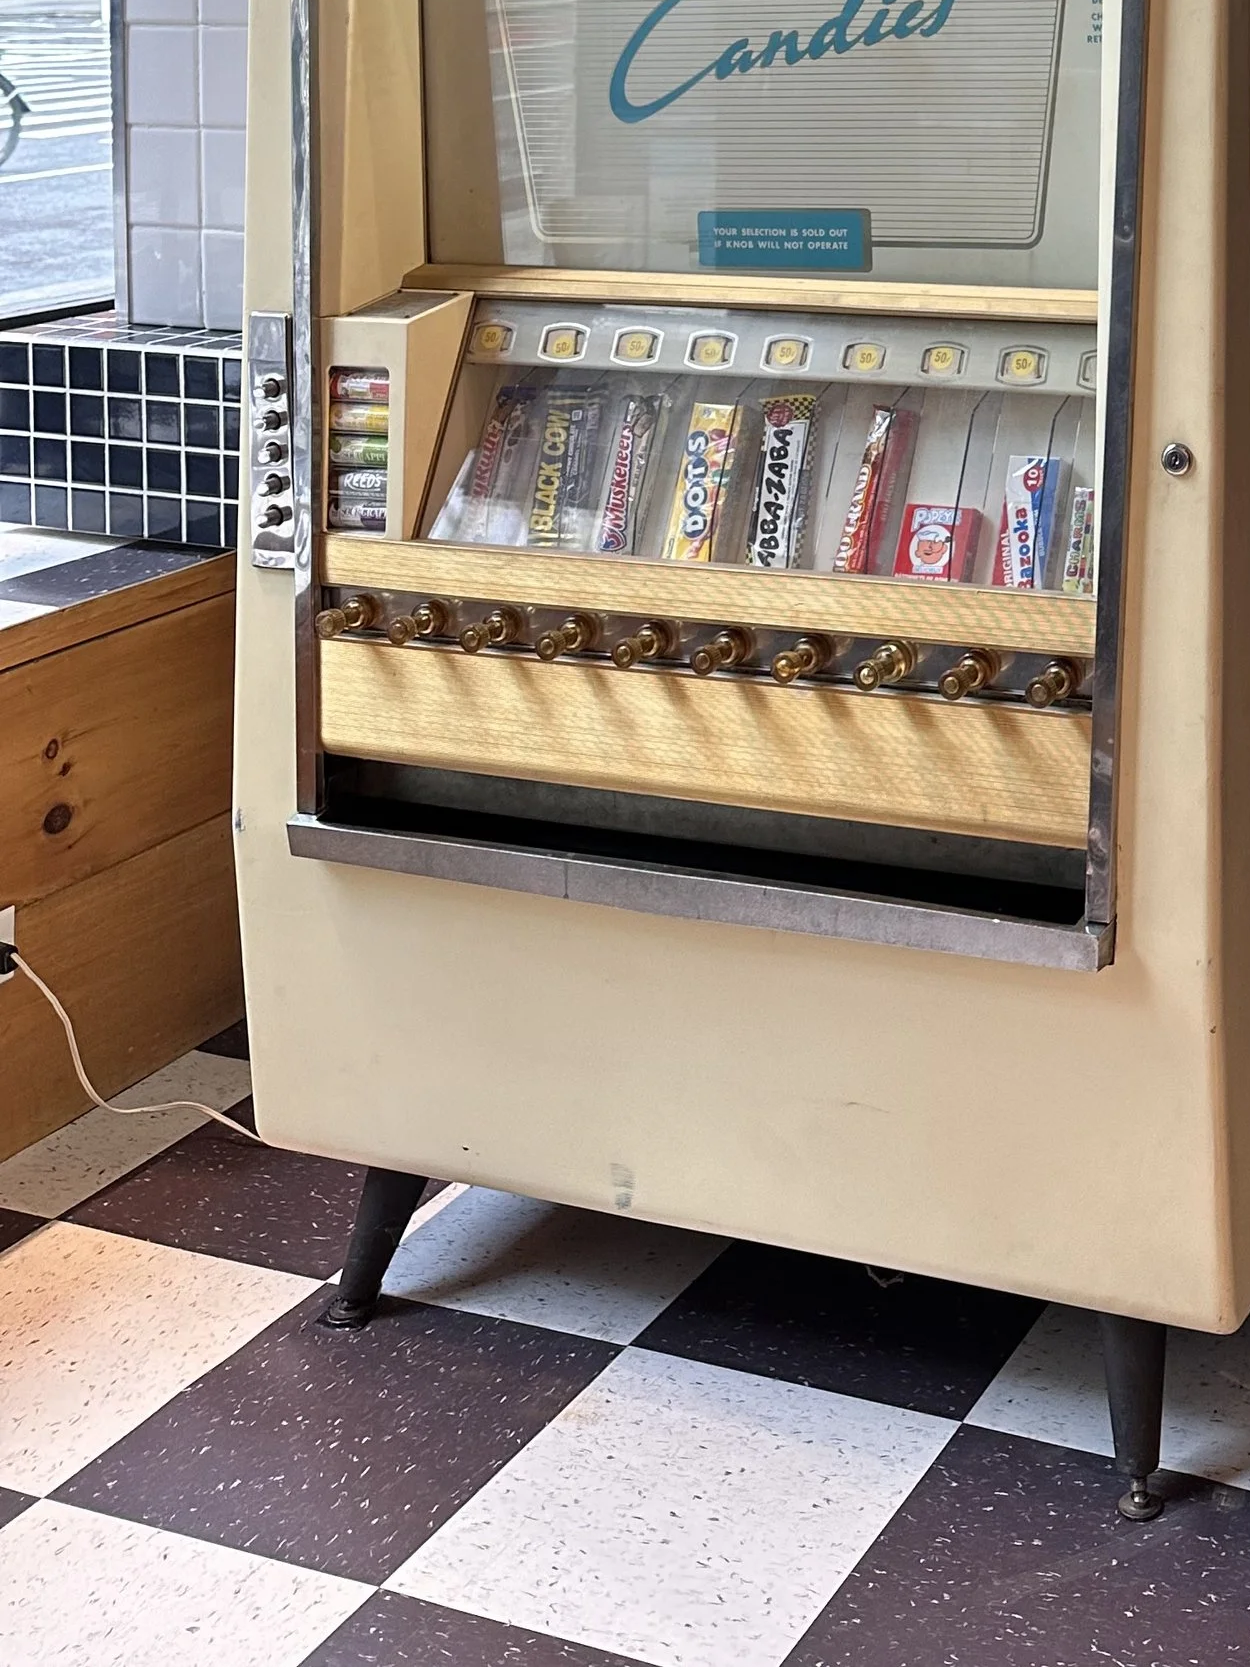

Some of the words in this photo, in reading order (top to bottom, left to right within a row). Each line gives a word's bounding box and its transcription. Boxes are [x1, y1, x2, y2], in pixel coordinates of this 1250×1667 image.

[712, 227, 738, 236] YOUR
[741, 228, 786, 237] SELECTION
[790, 228, 799, 237] IS
[801, 228, 825, 238] SOLD
[829, 228, 848, 238] OUT
[714, 240, 722, 248] IF
[725, 240, 754, 249] KNOB
[757, 240, 780, 250] WILL
[784, 241, 804, 250] NOT
[807, 241, 849, 250] OPERATE
[543, 409, 571, 456] COW
[343, 472, 382, 491] REED'S
[530, 461, 564, 533] BLACK
[602, 423, 636, 532] Musketeers
[683, 430, 710, 540] DOTS
[757, 428, 793, 568] ABBA-ZABA
[1026, 468, 1039, 487] 10
[599, 521, 628, 552] 3
[833, 535, 852, 572] 100
[845, 464, 871, 534] GRAND
[1066, 499, 1087, 578] CHARMS
